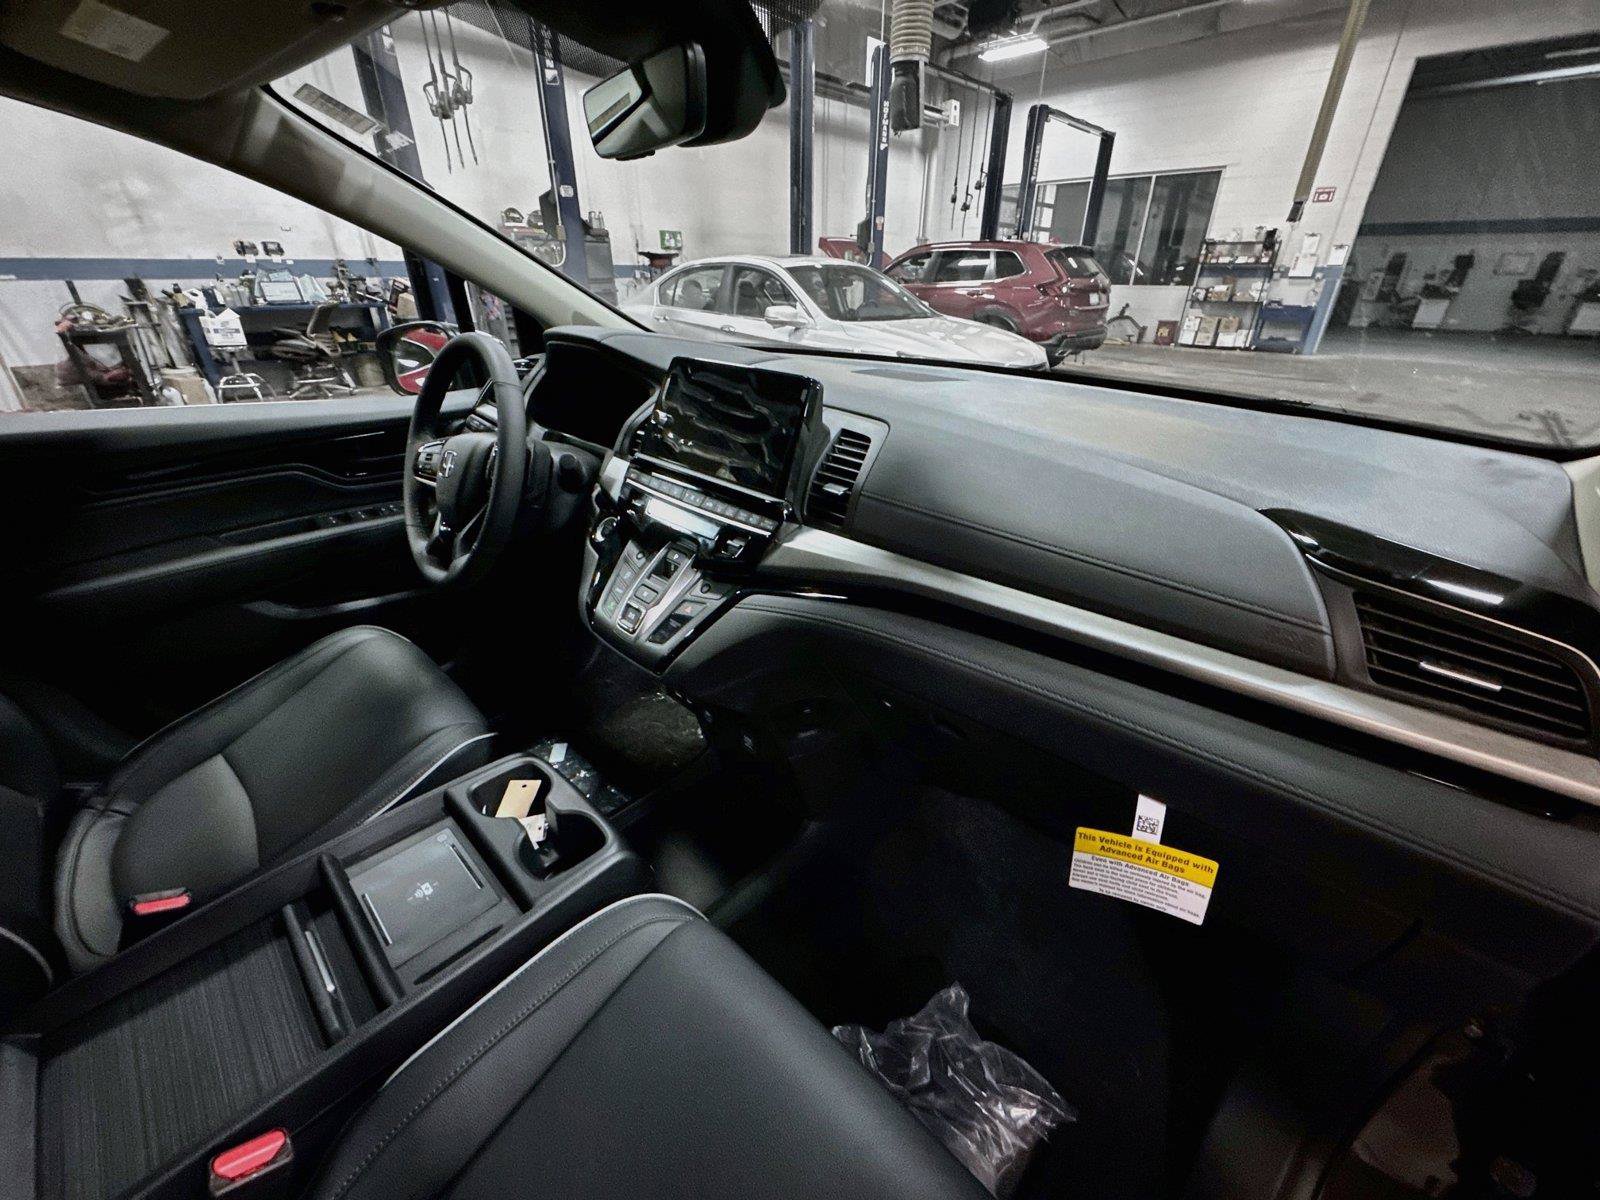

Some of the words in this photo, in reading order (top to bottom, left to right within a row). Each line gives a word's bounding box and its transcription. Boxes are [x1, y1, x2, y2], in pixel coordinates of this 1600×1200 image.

[1078, 831, 1096, 842] This
[1099, 836, 1132, 849] Vehicle
[1135, 844, 1143, 852] is
[1145, 848, 1190, 866] Equipped
[1192, 862, 1214, 874] with
[1099, 845, 1143, 861] Advanced
[1145, 856, 1160, 866] Air
[1161, 861, 1187, 874] Bags
[1124, 863, 1157, 876] Advanced
[1159, 872, 1170, 880] Air
